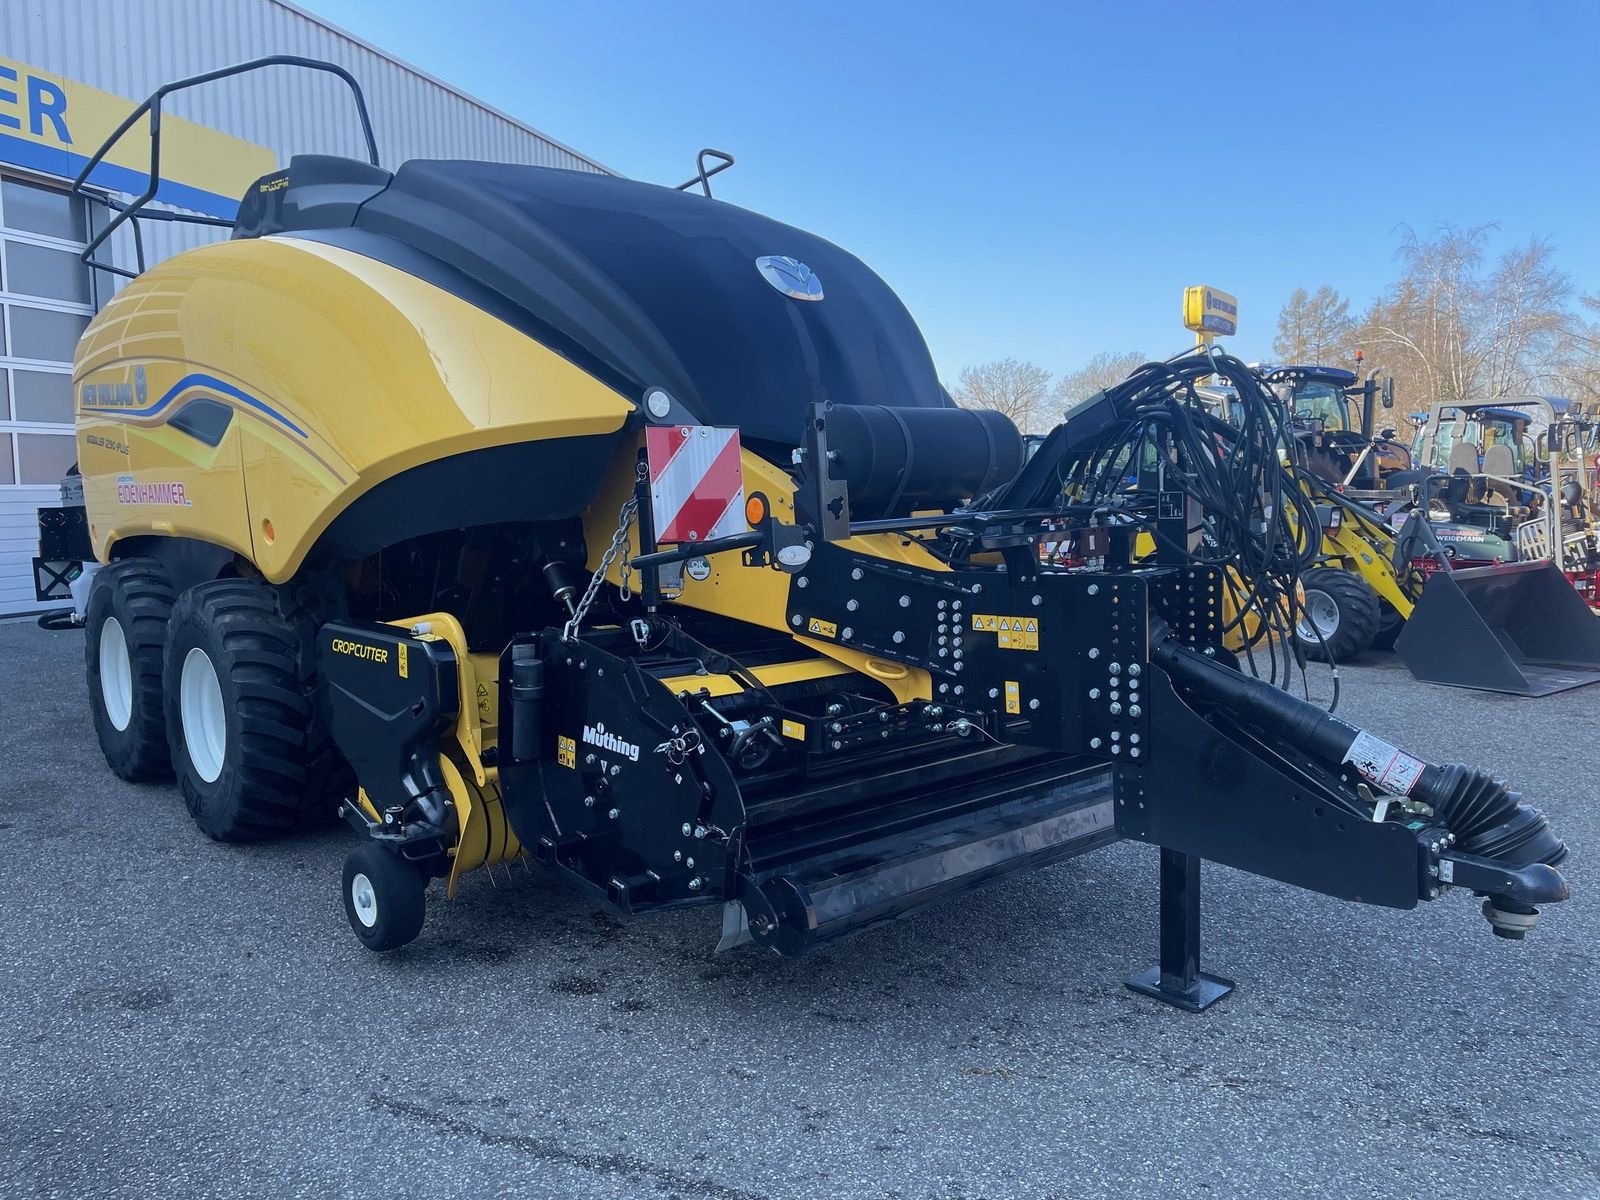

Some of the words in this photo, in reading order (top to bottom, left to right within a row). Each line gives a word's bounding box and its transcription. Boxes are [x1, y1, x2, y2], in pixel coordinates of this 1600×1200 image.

[116, 442, 129, 455] PLUS
[118, 483, 186, 504] EIDENHAMMER
[1436, 535, 1484, 543] WEIDEMANN
[691, 560, 704, 568] OK
[332, 639, 389, 663] CROPCUTTER
